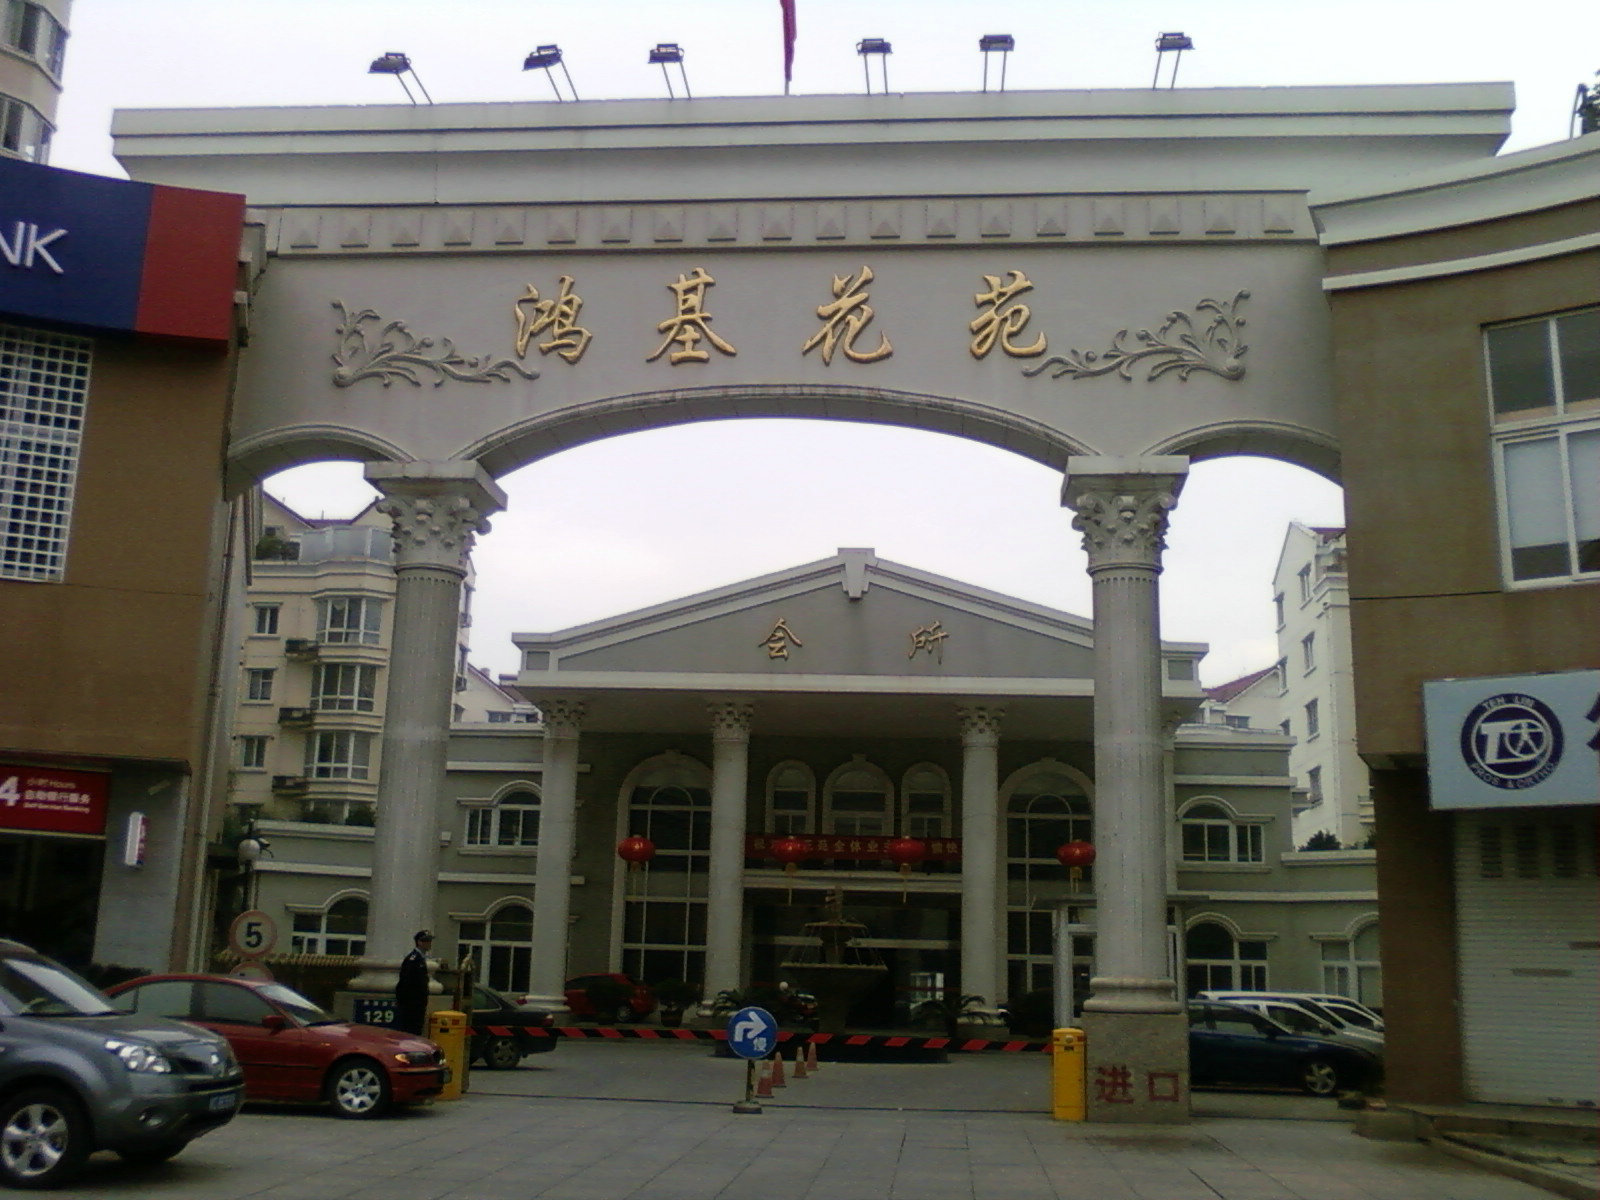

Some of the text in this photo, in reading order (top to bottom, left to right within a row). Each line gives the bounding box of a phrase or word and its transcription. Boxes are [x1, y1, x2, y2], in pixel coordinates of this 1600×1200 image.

[515, 267, 1048, 364] 鸿基花苑
[758, 616, 950, 666] 会所
[246, 922, 262, 948] 5
[364, 1010, 394, 1023] 129
[1095, 1064, 1180, 1104] 进口
